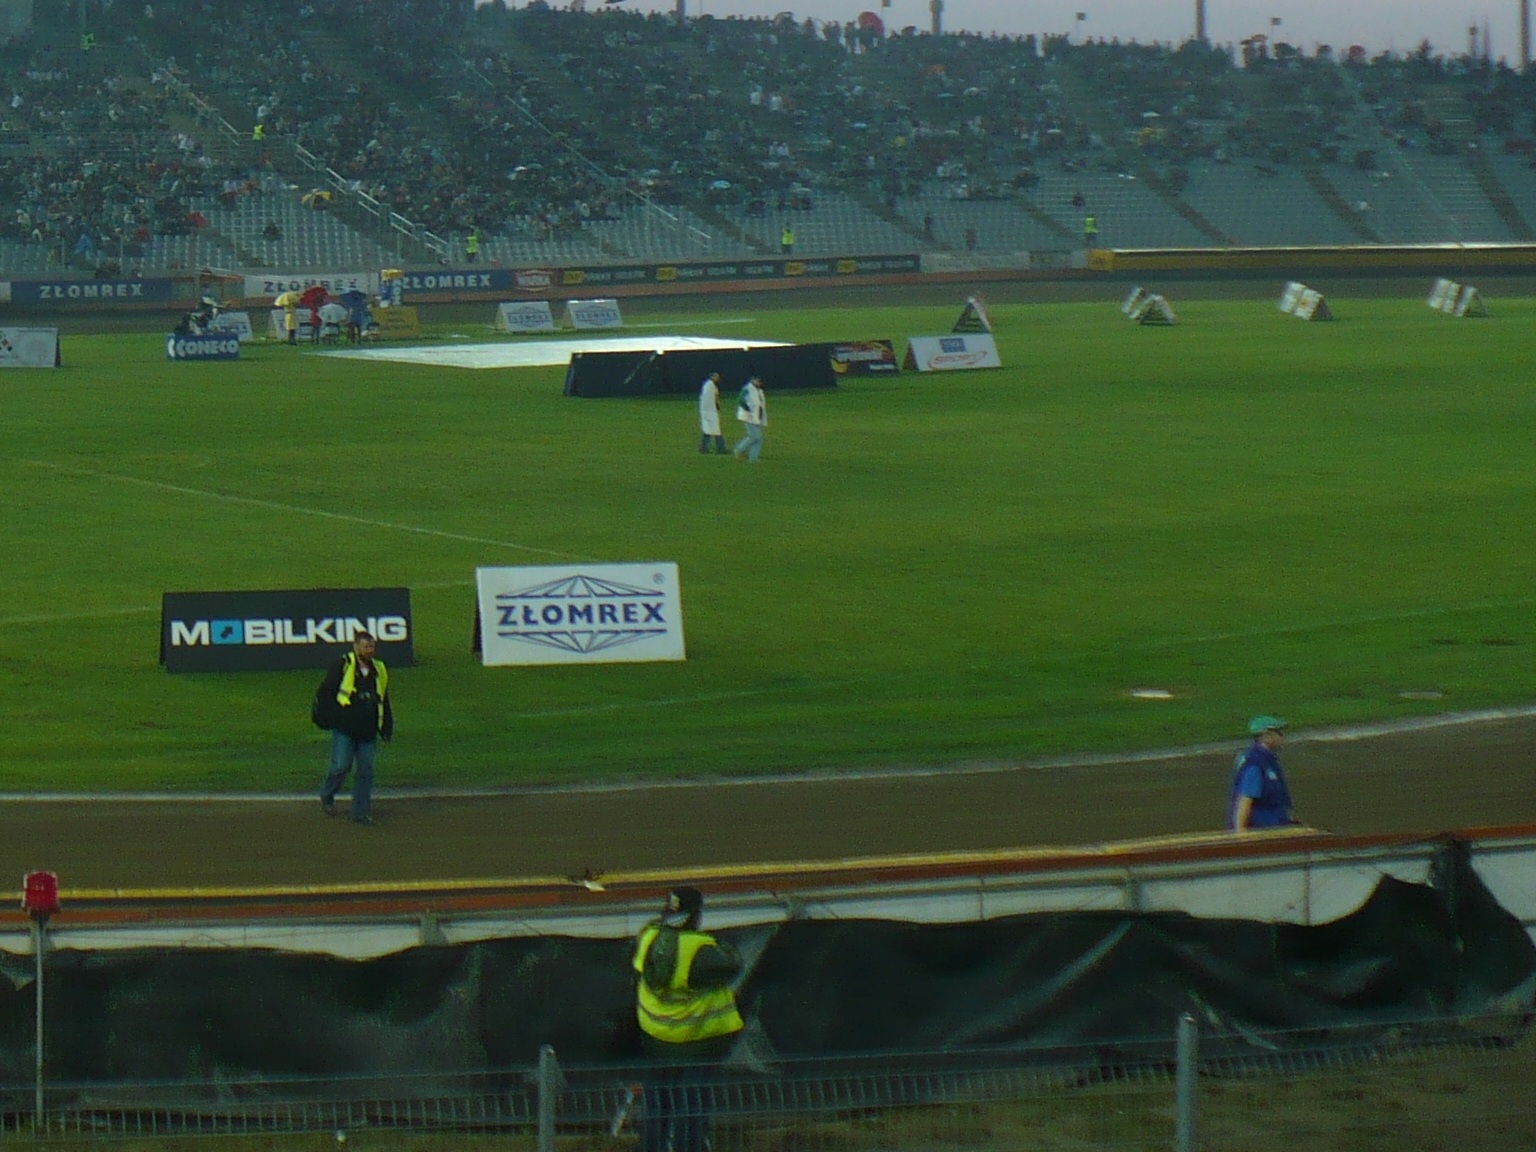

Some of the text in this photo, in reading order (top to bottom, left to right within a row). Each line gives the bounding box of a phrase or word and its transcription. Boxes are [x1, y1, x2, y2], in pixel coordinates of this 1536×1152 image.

[40, 283, 145, 299] ZŁOMREX
[403, 274, 491, 290] ZŁOMREX
[176, 339, 238, 358] CONECO
[496, 602, 667, 626] ZŁOMREX
[171, 616, 408, 646] MOBILKING
